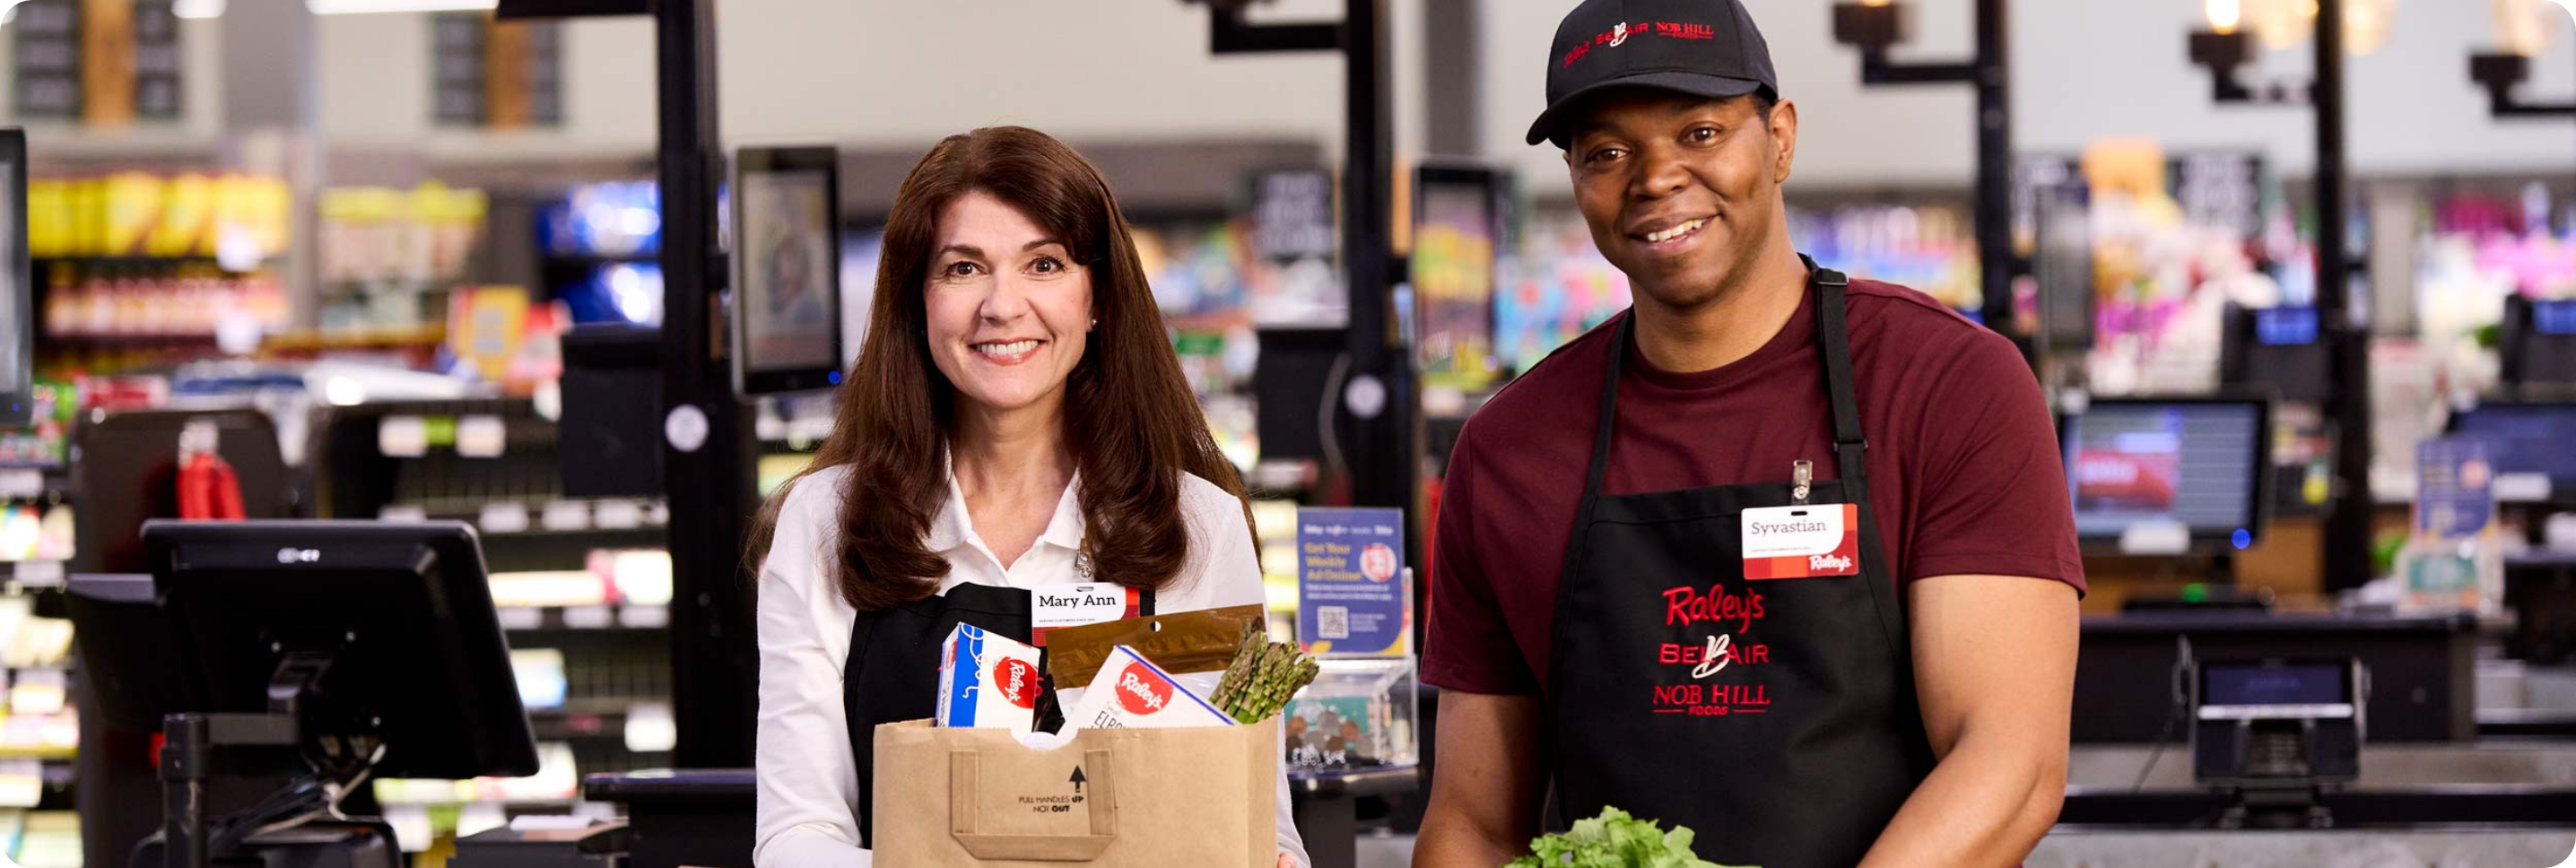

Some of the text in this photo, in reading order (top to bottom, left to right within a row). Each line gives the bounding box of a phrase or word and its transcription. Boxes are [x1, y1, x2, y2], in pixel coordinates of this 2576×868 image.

[1655, 22, 1714, 35] NOB HILL
[1751, 520, 1827, 537] Syvastian
[1808, 554, 1853, 572] Raley's
[1039, 595, 1116, 609] Mary Ann
[1662, 584, 1764, 634] Raley's
[1005, 661, 1026, 702] Raley's
[1120, 672, 1164, 709] Raley's
[1652, 684, 1771, 705] NOB HILL
[1688, 705, 1728, 716] FOODS
[1036, 795, 1070, 803] HANDLES
[1033, 805, 1049, 813] NOT
